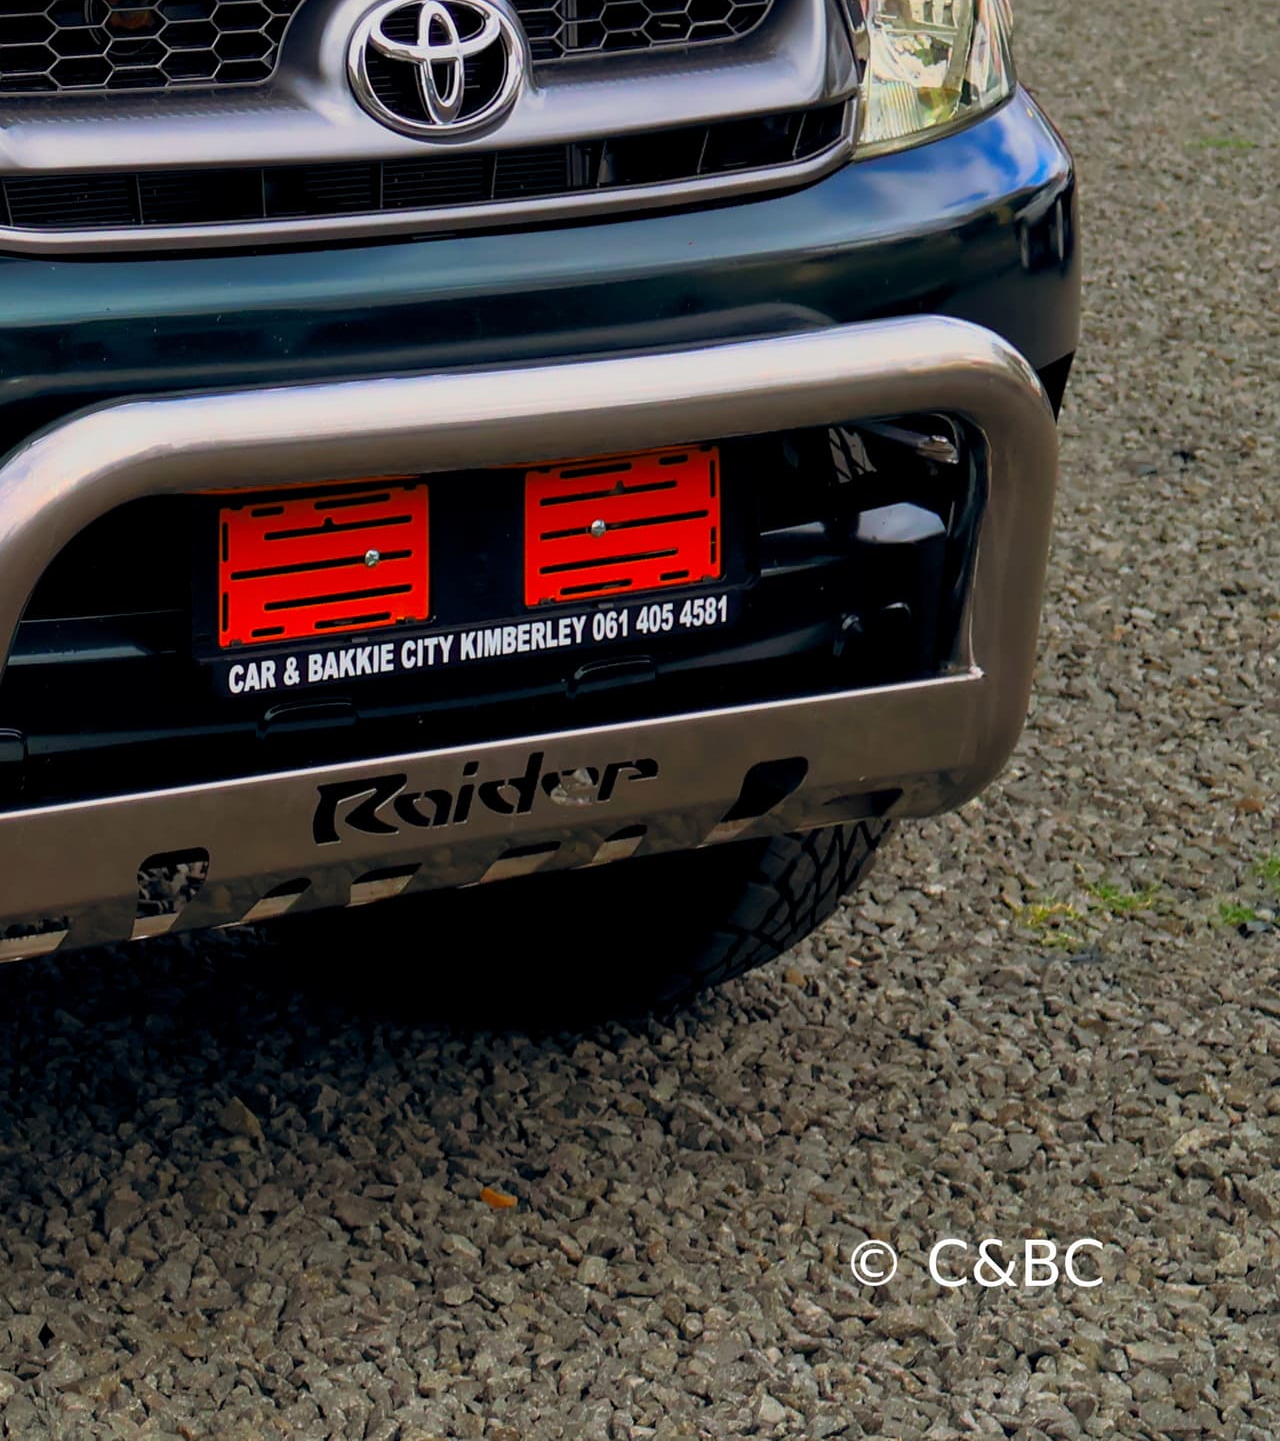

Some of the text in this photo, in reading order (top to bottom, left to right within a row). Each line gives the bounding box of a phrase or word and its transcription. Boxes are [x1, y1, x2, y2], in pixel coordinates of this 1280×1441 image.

[228, 594, 727, 694] CAR & BAKKIE CITY KIMBERLEY 061 405 4581
[311, 750, 661, 846] Raider
